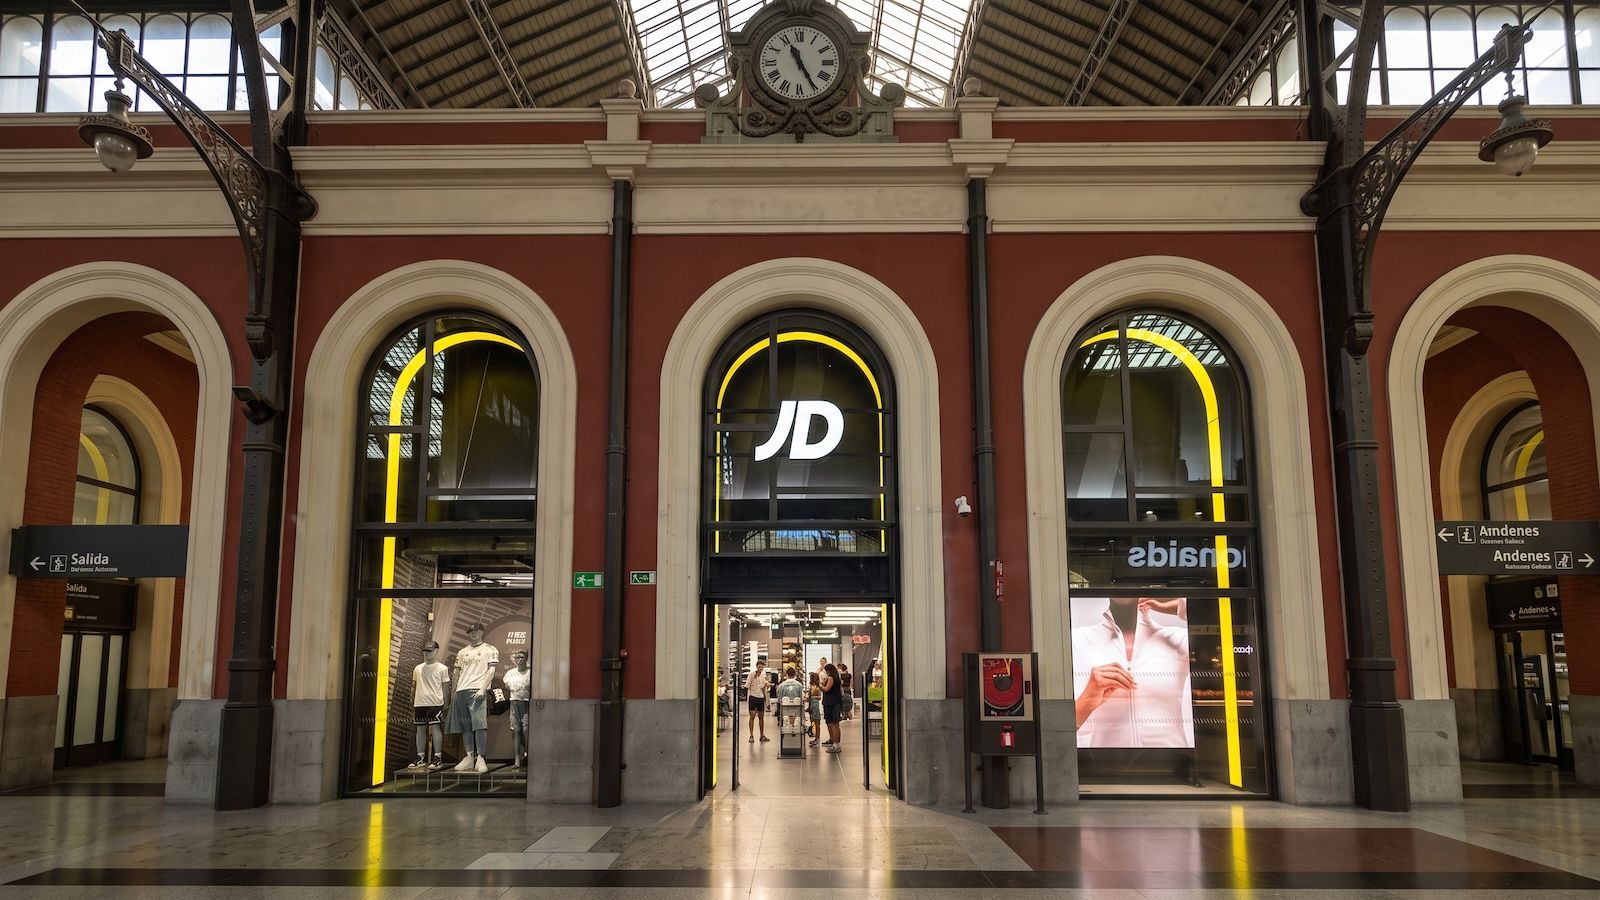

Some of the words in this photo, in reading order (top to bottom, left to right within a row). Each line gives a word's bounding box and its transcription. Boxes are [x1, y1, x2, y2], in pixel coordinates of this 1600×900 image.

[794, 31, 804, 42] XII
[810, 35, 818, 45] I
[818, 45, 831, 54] II
[755, 400, 844, 461] JD
[71, 553, 109, 565] Salida
[1494, 550, 1550, 562] Andenes
[66, 583, 88, 592] Salida
[1518, 606, 1549, 614] Andenes
